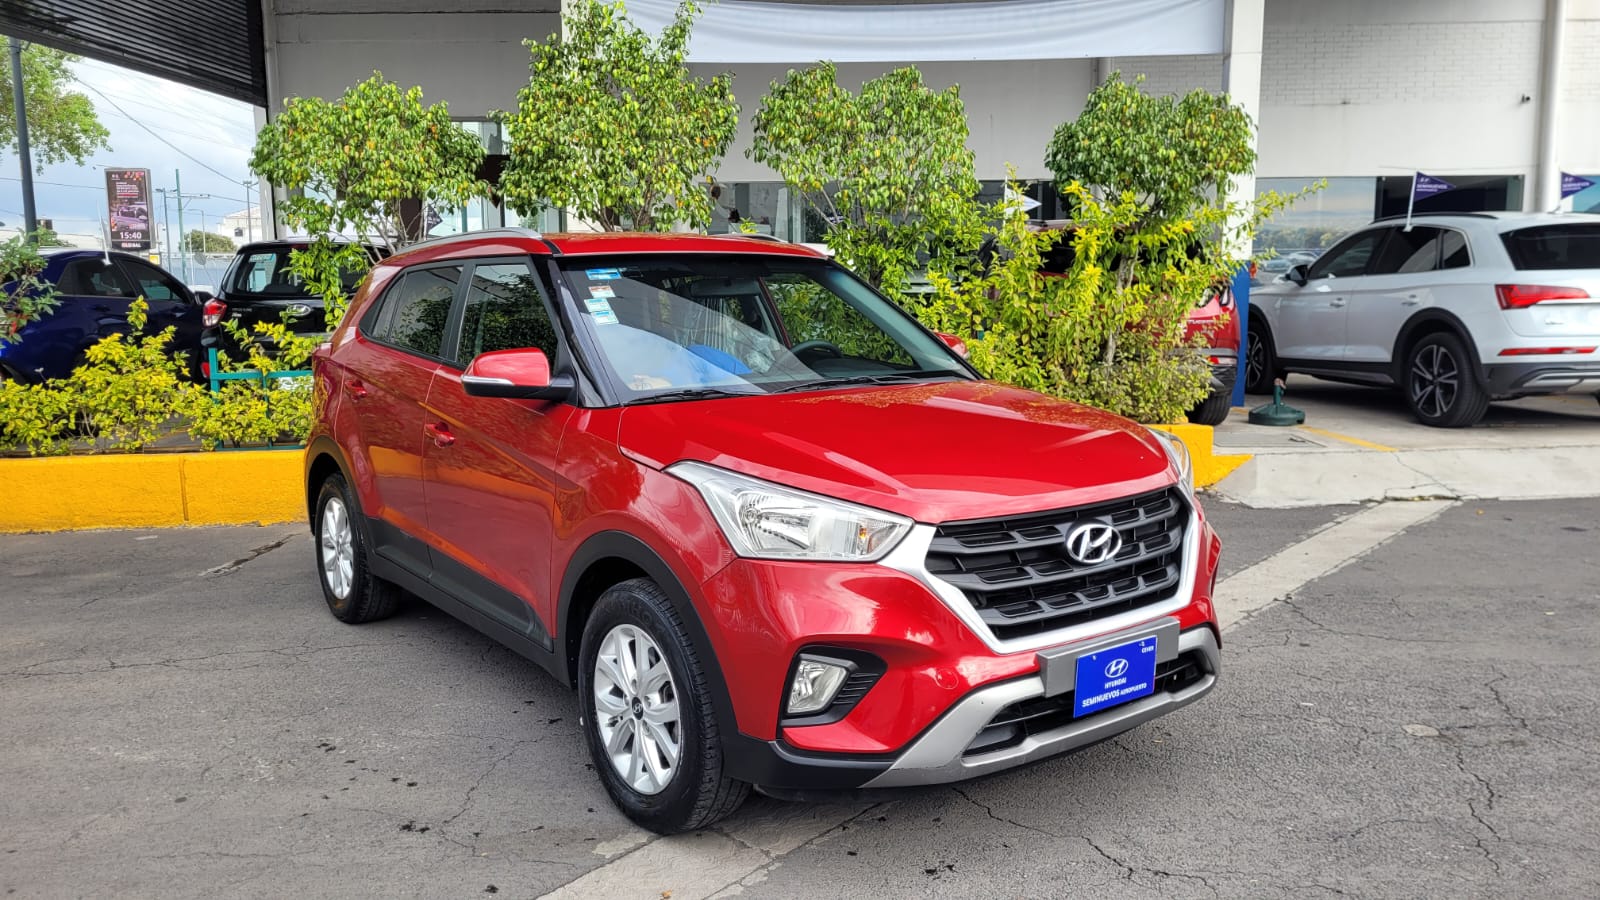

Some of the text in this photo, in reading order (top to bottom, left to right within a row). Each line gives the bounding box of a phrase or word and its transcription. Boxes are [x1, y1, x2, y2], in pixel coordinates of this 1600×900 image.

[120, 232, 142, 240] 15:40
[1104, 677, 1127, 690] HYUNDAI
[1082, 682, 1147, 707] SEMINUEVOS AEROPUERTO
